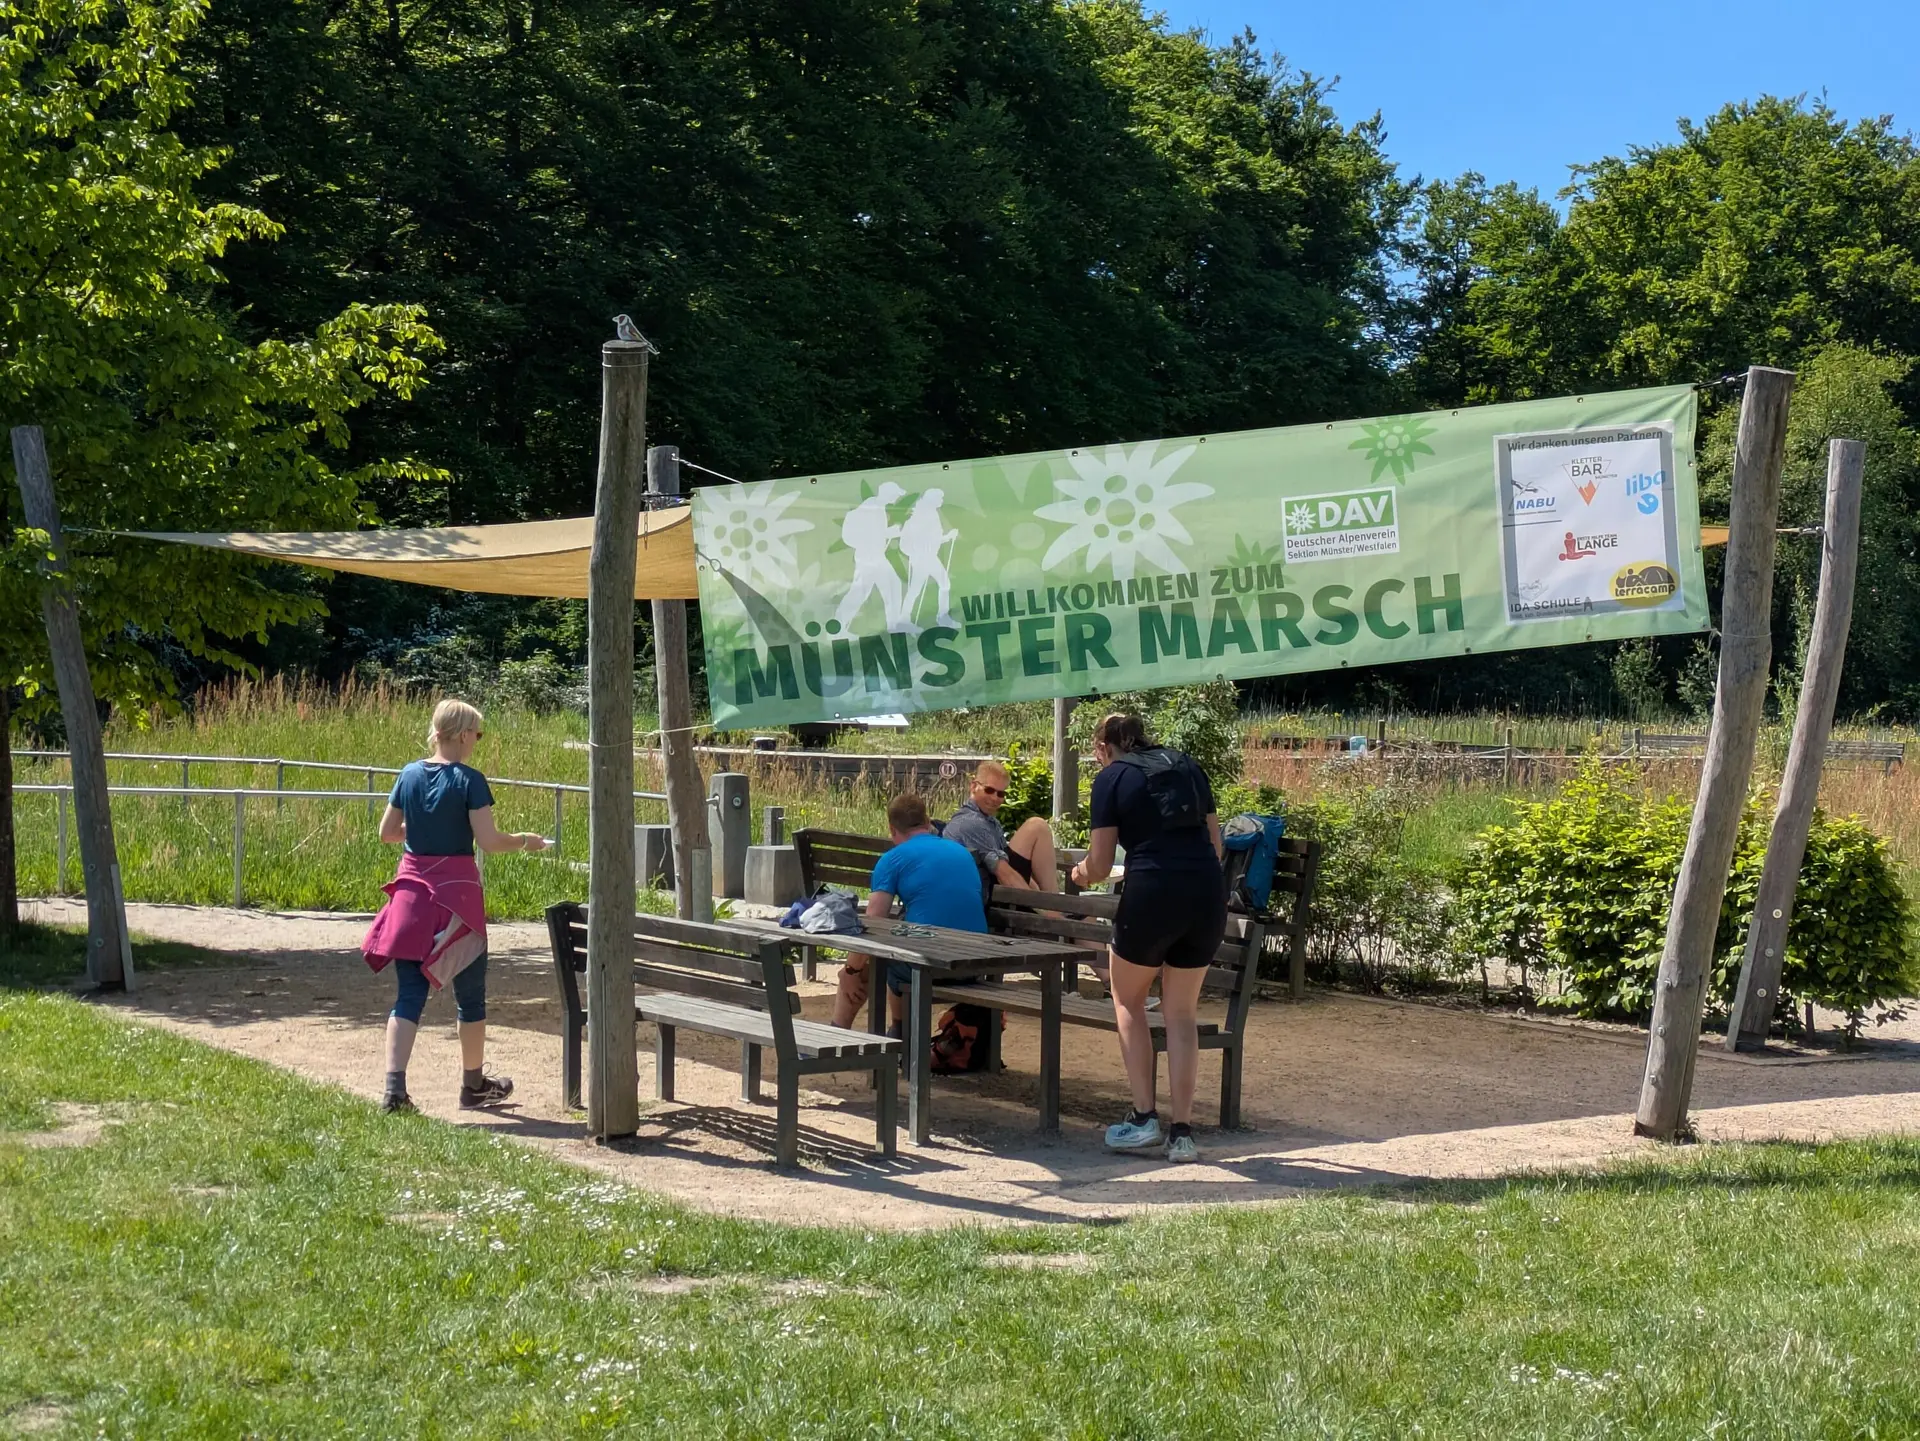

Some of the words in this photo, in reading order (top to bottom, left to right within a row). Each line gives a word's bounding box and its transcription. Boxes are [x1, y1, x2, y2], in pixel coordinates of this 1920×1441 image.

[1508, 441, 1525, 452] Wir
[1528, 439, 1568, 450] danken
[1571, 434, 1614, 446] unseren
[1617, 430, 1663, 442] Partnern
[1571, 456, 1603, 465] KLETTER
[1571, 463, 1603, 477] BAR
[1318, 494, 1389, 528] DAV
[1516, 496, 1556, 510] NABU
[1286, 536, 1336, 549] Deutscher
[1338, 529, 1396, 545] Alpenverein
[1577, 537, 1618, 551] LANGE
[1287, 549, 1319, 560] Sektion
[1320, 541, 1397, 557] Münster/Westfalen
[959, 572, 1200, 622] WILLKOMMEN
[1209, 563, 1286, 596] ZUM
[1615, 584, 1676, 597] terracamp
[1510, 602, 1530, 613] IDA
[1534, 597, 1581, 611] SCHULE
[733, 611, 1120, 706] MÜNSTER
[1138, 572, 1466, 665] MARSCH
